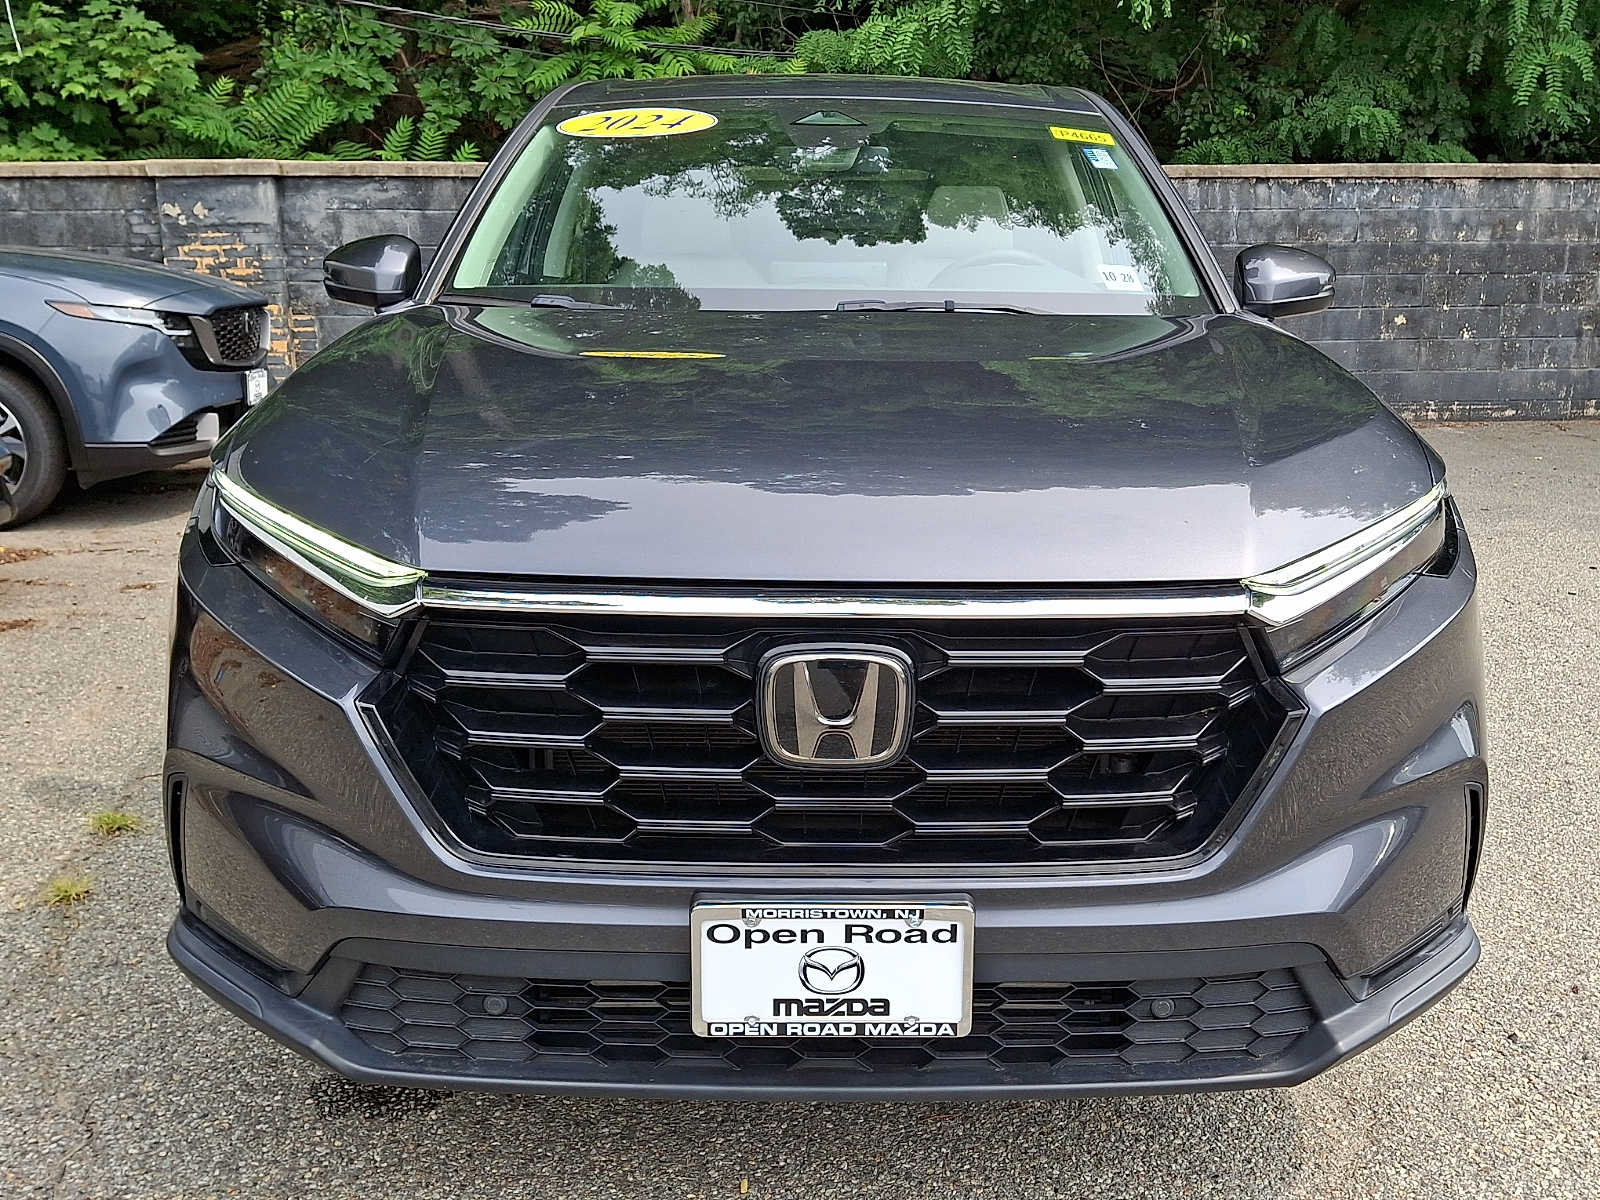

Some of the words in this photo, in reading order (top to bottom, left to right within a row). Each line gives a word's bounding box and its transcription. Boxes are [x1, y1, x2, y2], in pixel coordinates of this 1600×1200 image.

[578, 113, 695, 132] 2024
[1102, 271, 1117, 281] 10
[745, 908, 888, 920] MORRISTOWN,
[706, 923, 825, 949] Open
[844, 923, 958, 944] Road
[710, 1023, 778, 1037] OPEN
[787, 1023, 857, 1037] ROAD
[864, 1023, 956, 1037] MAZDA
